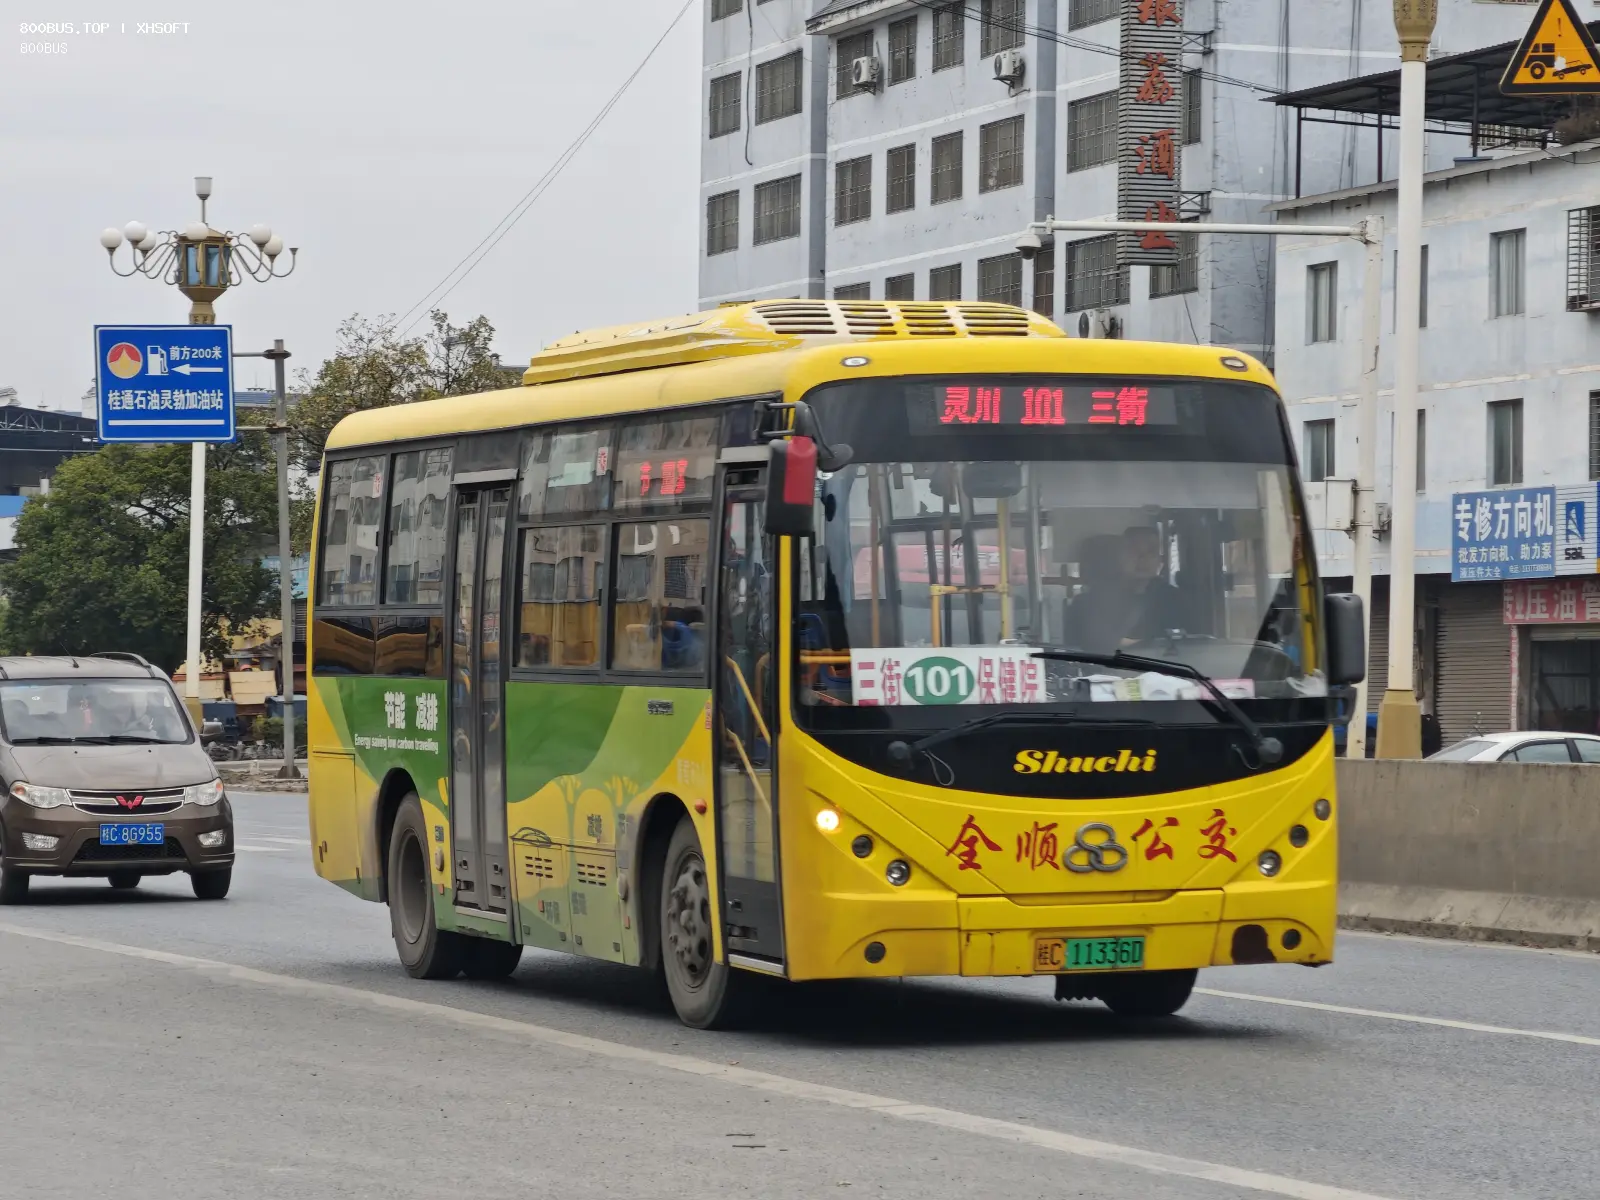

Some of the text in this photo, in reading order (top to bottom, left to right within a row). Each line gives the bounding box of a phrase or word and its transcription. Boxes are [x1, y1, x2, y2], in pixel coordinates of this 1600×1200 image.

[169, 345, 222, 361] 前方200米
[107, 389, 224, 410] 桂通石油灵勃加油站
[939, 386, 1148, 425] 灵川 101 三街
[1454, 492, 1554, 542] 专修方向机
[857, 656, 902, 706] 三街
[907, 665, 969, 697] 101
[384, 691, 438, 732] 节能 减排
[1013, 749, 1157, 774] Shuchi
[945, 808, 1238, 871] 全顺 公交
